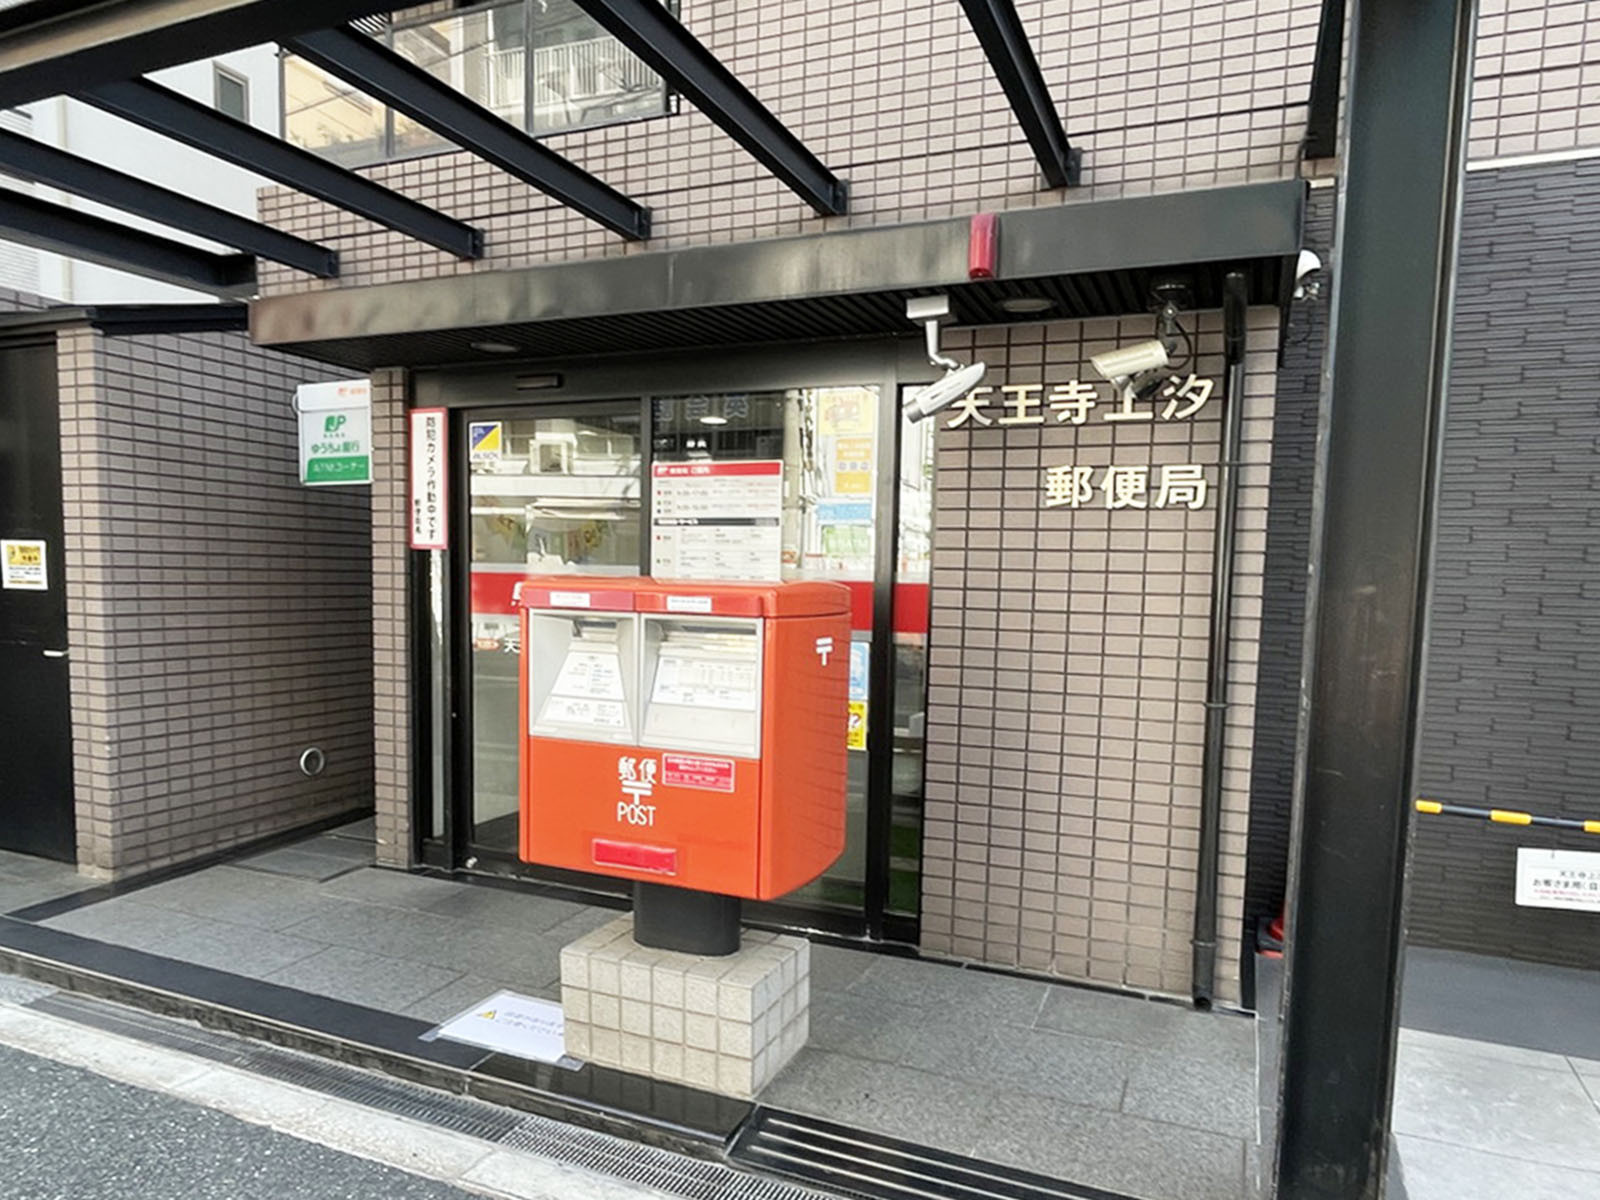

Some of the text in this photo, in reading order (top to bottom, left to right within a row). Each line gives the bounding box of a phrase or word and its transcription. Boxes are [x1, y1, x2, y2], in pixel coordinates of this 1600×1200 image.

[947, 374, 1215, 428] 天王寺上汐
[311, 440, 360, 454] ゆうちょ銀行
[1045, 464, 1208, 510] 郵便局
[618, 757, 657, 784] 郵便
[616, 802, 657, 827] POST
